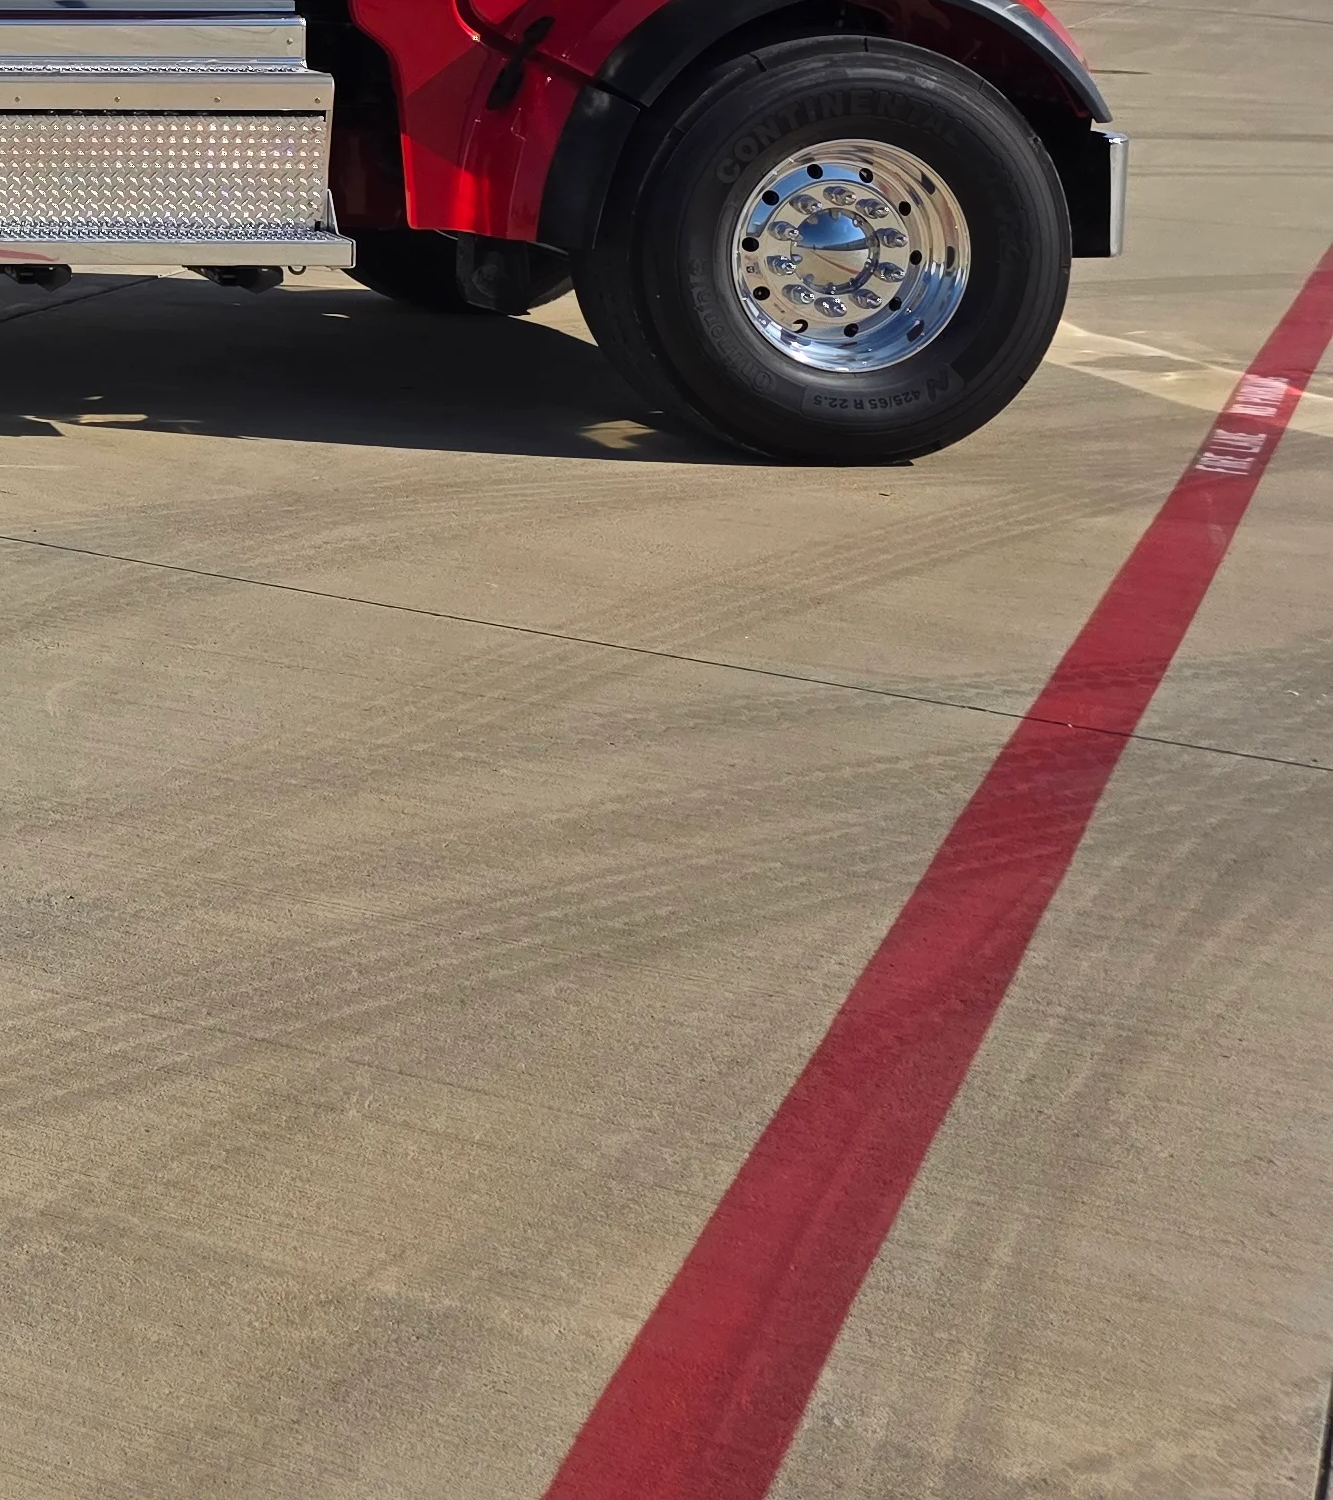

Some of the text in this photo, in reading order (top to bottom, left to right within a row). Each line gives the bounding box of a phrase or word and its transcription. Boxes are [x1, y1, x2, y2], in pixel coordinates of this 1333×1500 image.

[715, 88, 961, 184] CONTINENTAL
[812, 389, 921, 410] 425/65 R 22.5
